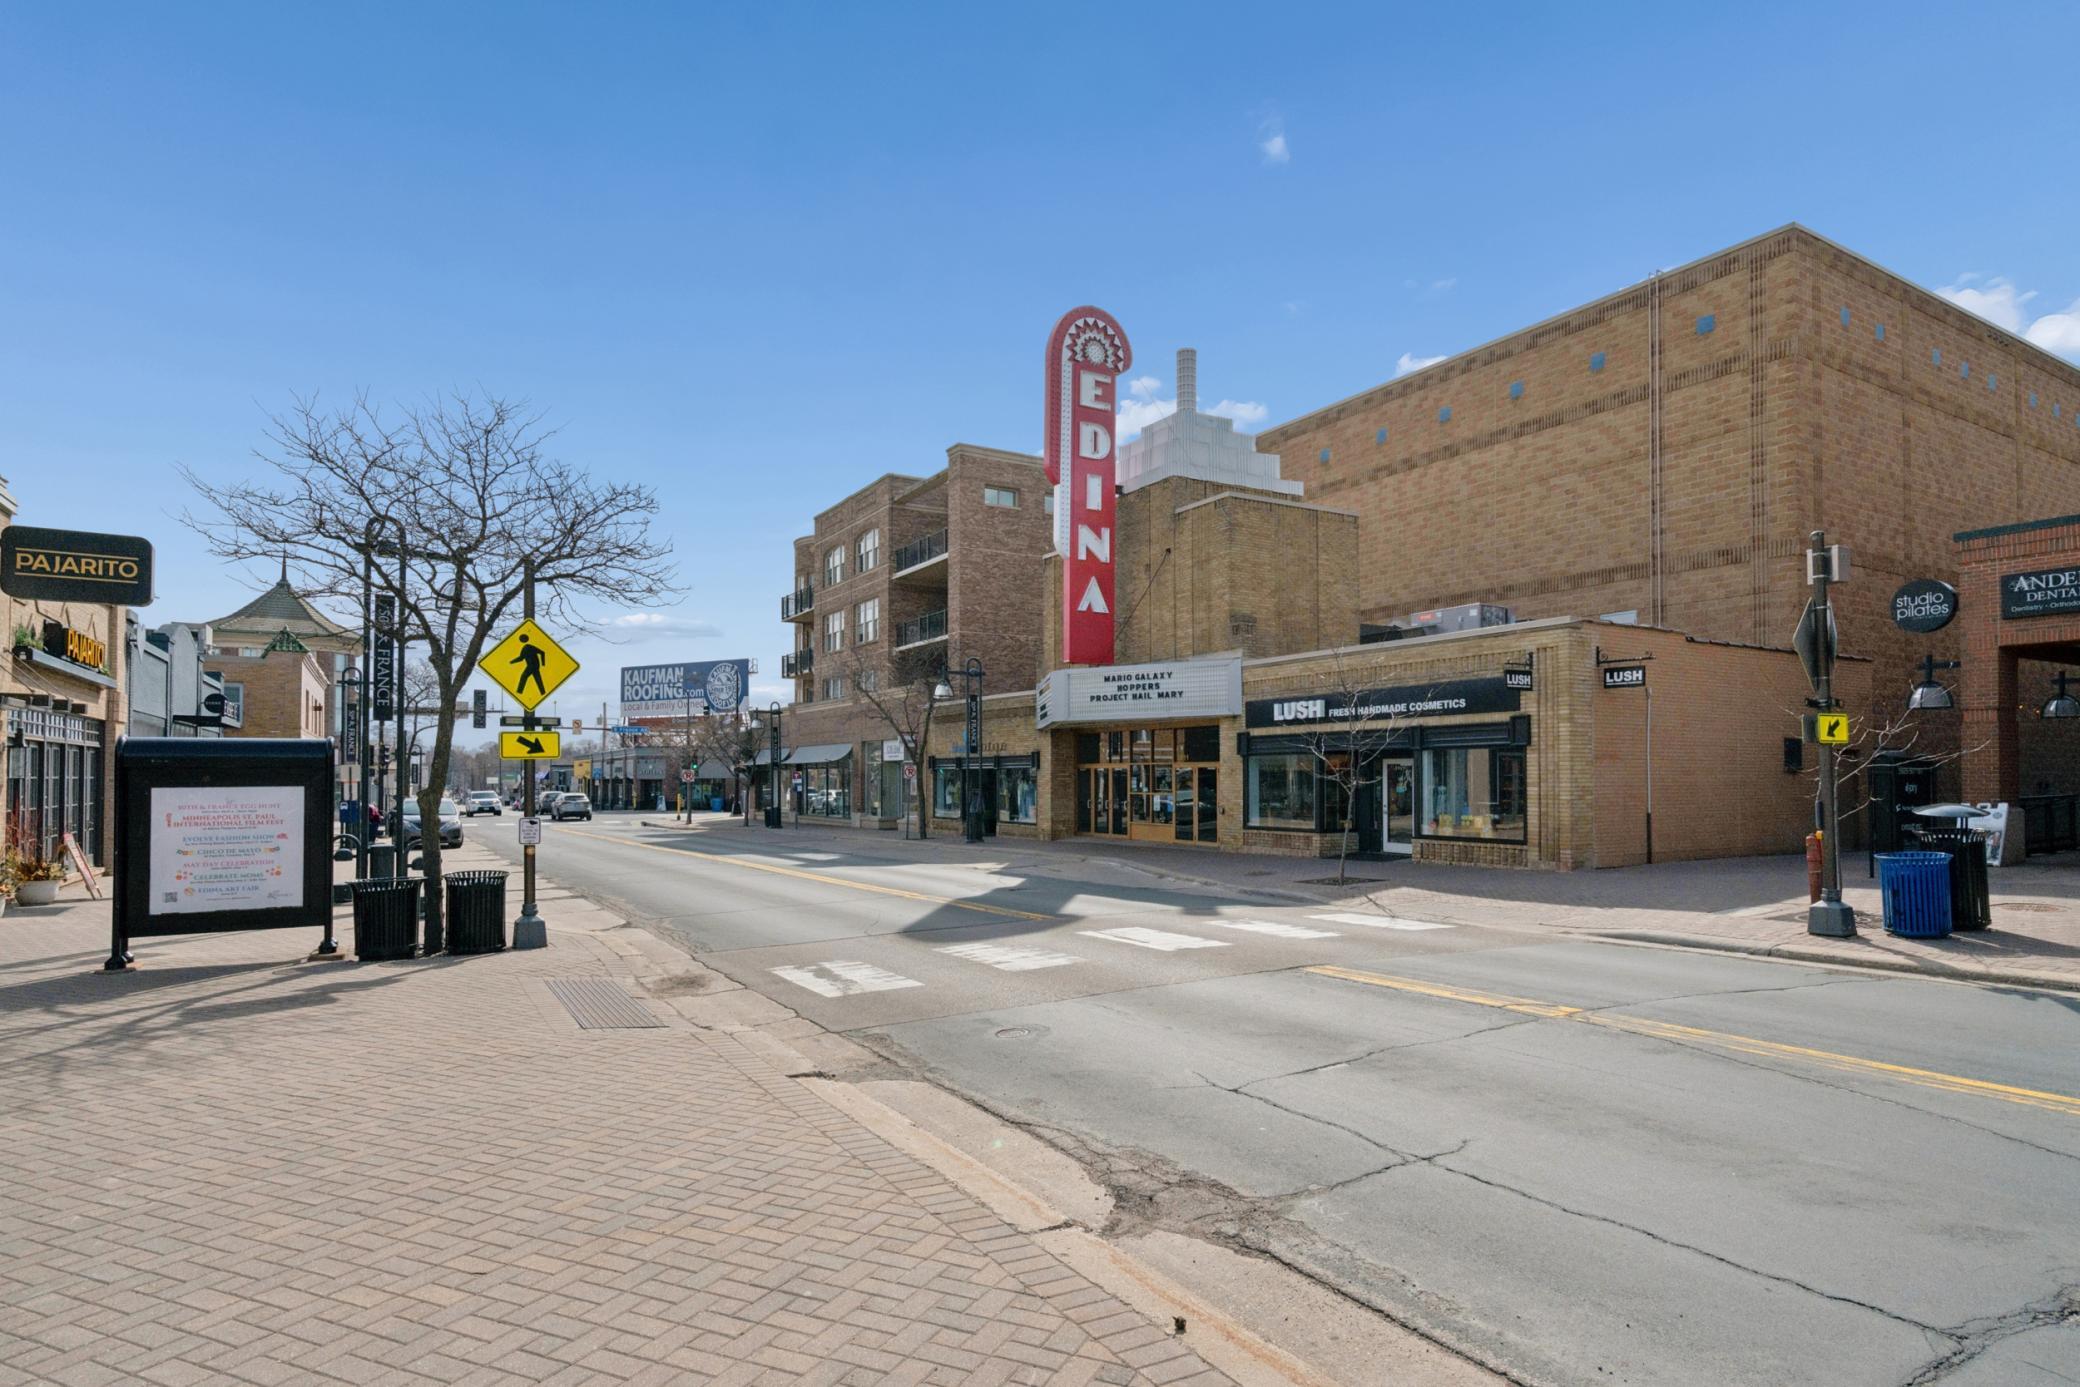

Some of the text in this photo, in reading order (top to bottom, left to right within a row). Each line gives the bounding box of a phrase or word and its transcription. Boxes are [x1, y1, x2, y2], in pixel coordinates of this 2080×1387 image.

[1077, 370, 1112, 614] EDINA
[15, 552, 139, 578] PAJARITO
[2013, 571, 2080, 592] ANDE
[1896, 592, 1944, 608] studio
[2026, 587, 2080, 602] DENTA
[1896, 602, 1949, 620] pilates
[66, 627, 106, 668] PAJARITO
[377, 649, 391, 707] FRANCE
[624, 666, 684, 686] KAUFMAN
[1104, 671, 1173, 683] MARIO GALAXY
[1506, 673, 1531, 685] LUSH
[1605, 670, 1643, 683] LUSH
[1117, 682, 1160, 692] HOPPERS
[1090, 690, 1184, 702] PROJECT HAIL MARY
[624, 699, 704, 711] Local & Family Owned
[1273, 699, 1466, 721] LUSH FRESH HANDMADE COSMETICS
[173, 820, 244, 828] INTERNATIONAL
